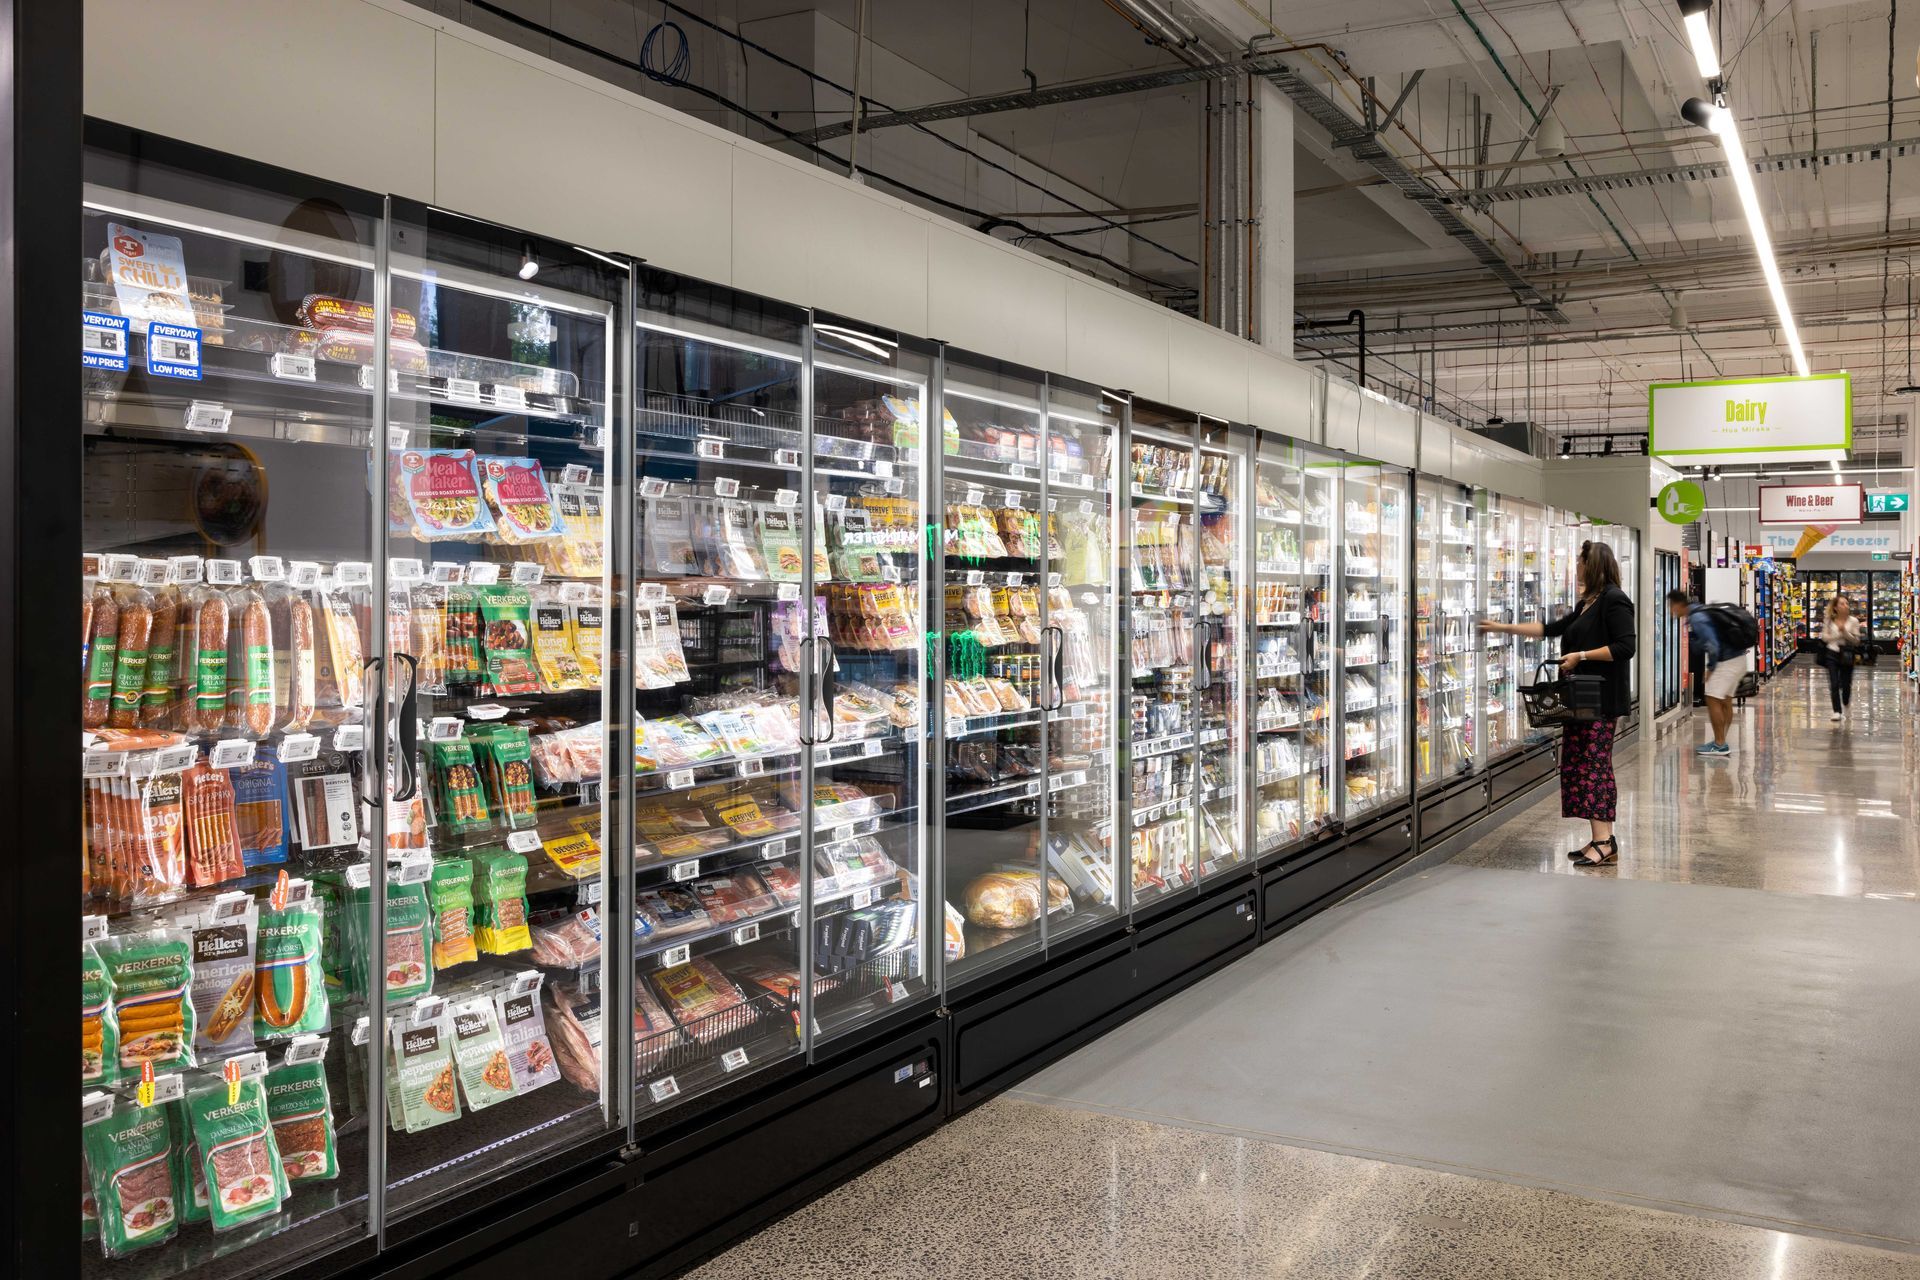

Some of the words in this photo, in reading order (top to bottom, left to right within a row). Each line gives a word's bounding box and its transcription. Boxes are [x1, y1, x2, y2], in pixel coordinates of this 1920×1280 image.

[118, 257, 156, 271] SWEET
[314, 306, 346, 314] CHICKEN
[83, 314, 125, 328] VERYDAY
[154, 325, 198, 339] EVERYDAY
[83, 355, 97, 365] OW
[100, 357, 124, 368] PRICE
[154, 364, 173, 374] LOW
[174, 367, 198, 377] PRICE
[1726, 399, 1767, 424] Dairy
[424, 461, 458, 476] Meal
[418, 474, 467, 490] Maker
[506, 471, 530, 484] Meal
[502, 482, 538, 497] Maker
[1786, 495, 1806, 507] Wine
[1807, 494, 1813, 506] &
[1815, 494, 1834, 507] Beer
[1767, 535, 1795, 546] The
[1830, 535, 1890, 546] Freezer
[484, 595, 528, 605] VERKERKS
[540, 615, 562, 625] Hellers
[257, 924, 309, 937] ERKERKS
[198, 937, 244, 953] Hellers
[115, 954, 182, 974] VERKERKS
[194, 962, 254, 979] merican
[507, 1005, 532, 1018] Hellers
[405, 1036, 436, 1049] Hellers
[400, 1056, 450, 1080] pepperoni
[266, 1078, 322, 1096] VERKERKS
[203, 1098, 260, 1121] VERKERKS
[270, 1101, 298, 1113] HORIZO
[108, 1117, 165, 1143] VERKERKS
